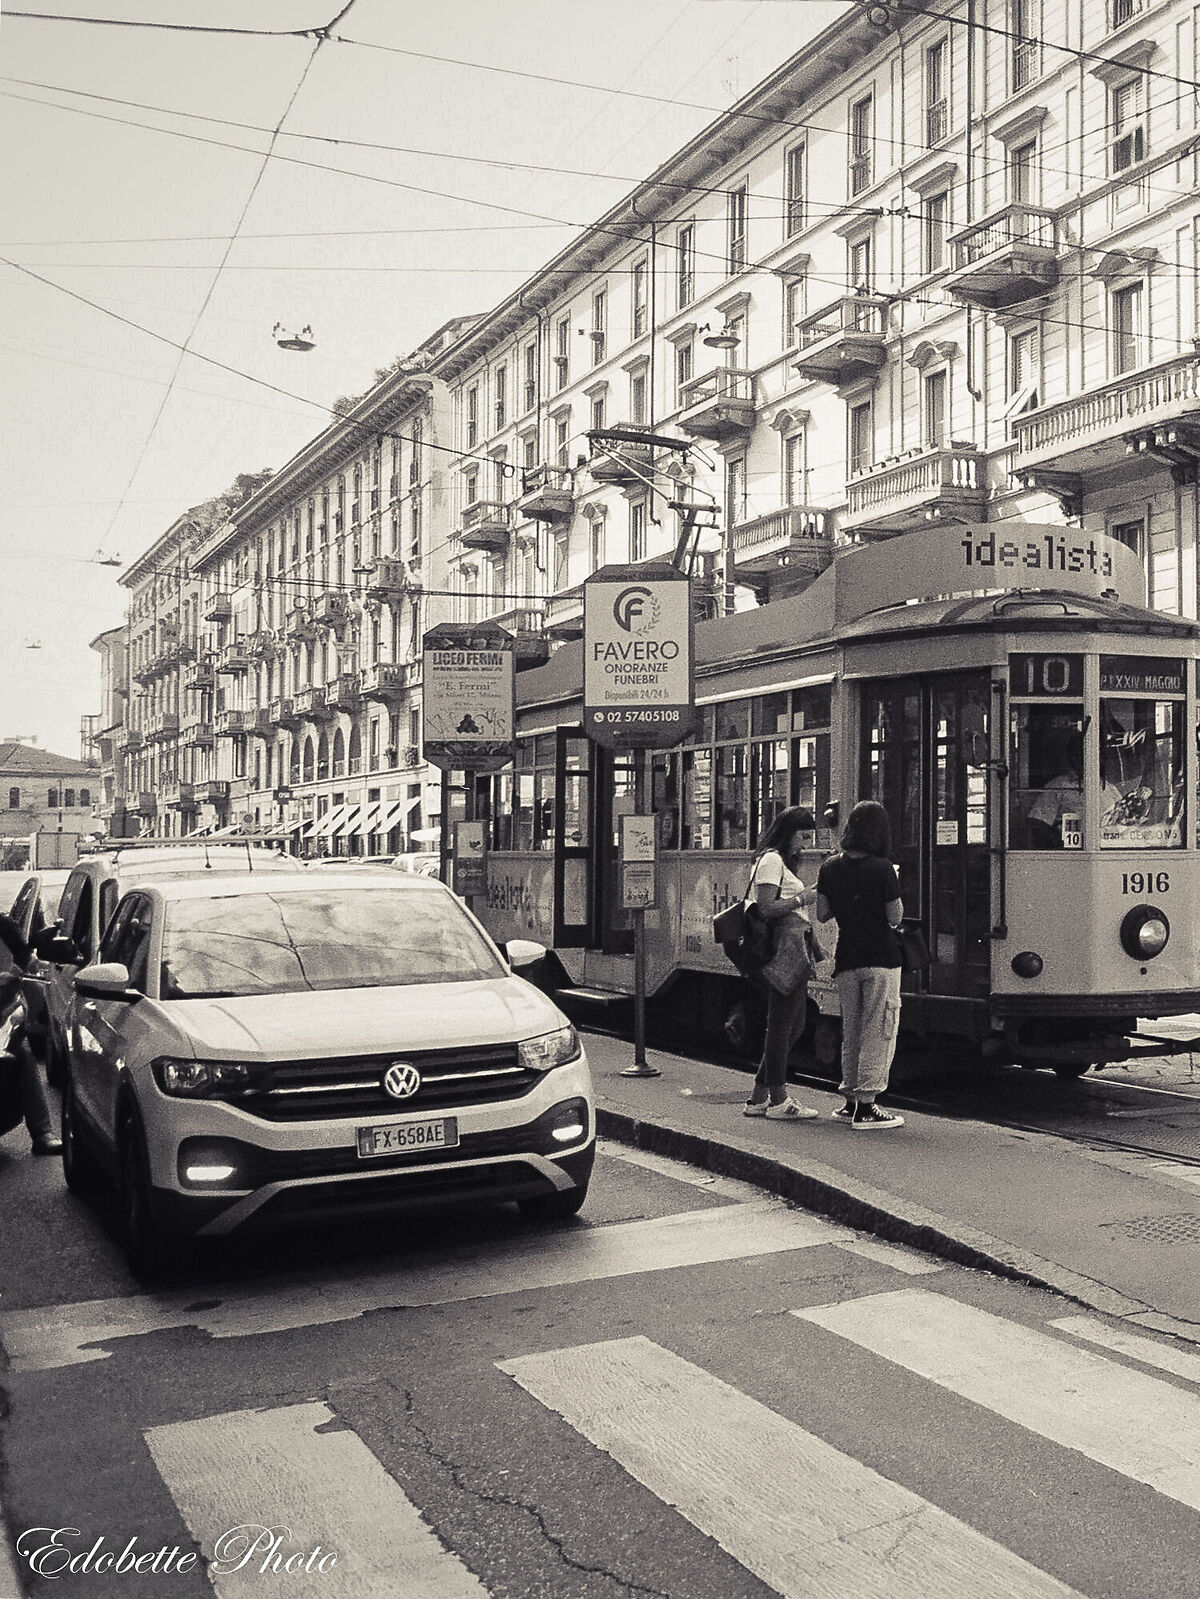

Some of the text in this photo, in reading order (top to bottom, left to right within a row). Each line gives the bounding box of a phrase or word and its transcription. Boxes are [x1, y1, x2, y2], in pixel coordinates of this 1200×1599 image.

[961, 531, 1112, 577] idealista
[594, 641, 679, 661] FAVERO
[432, 652, 503, 666] LICEO FERMI
[604, 662, 669, 674] ONORANZE
[1025, 657, 1071, 693] 10
[614, 674, 659, 685] FUNEBRI
[1145, 675, 1181, 690] MAGGIO
[640, 689, 663, 699] 24/24
[607, 710, 680, 723] 02 57405108
[1066, 833, 1080, 846] 10
[1121, 872, 1170, 895] 1916
